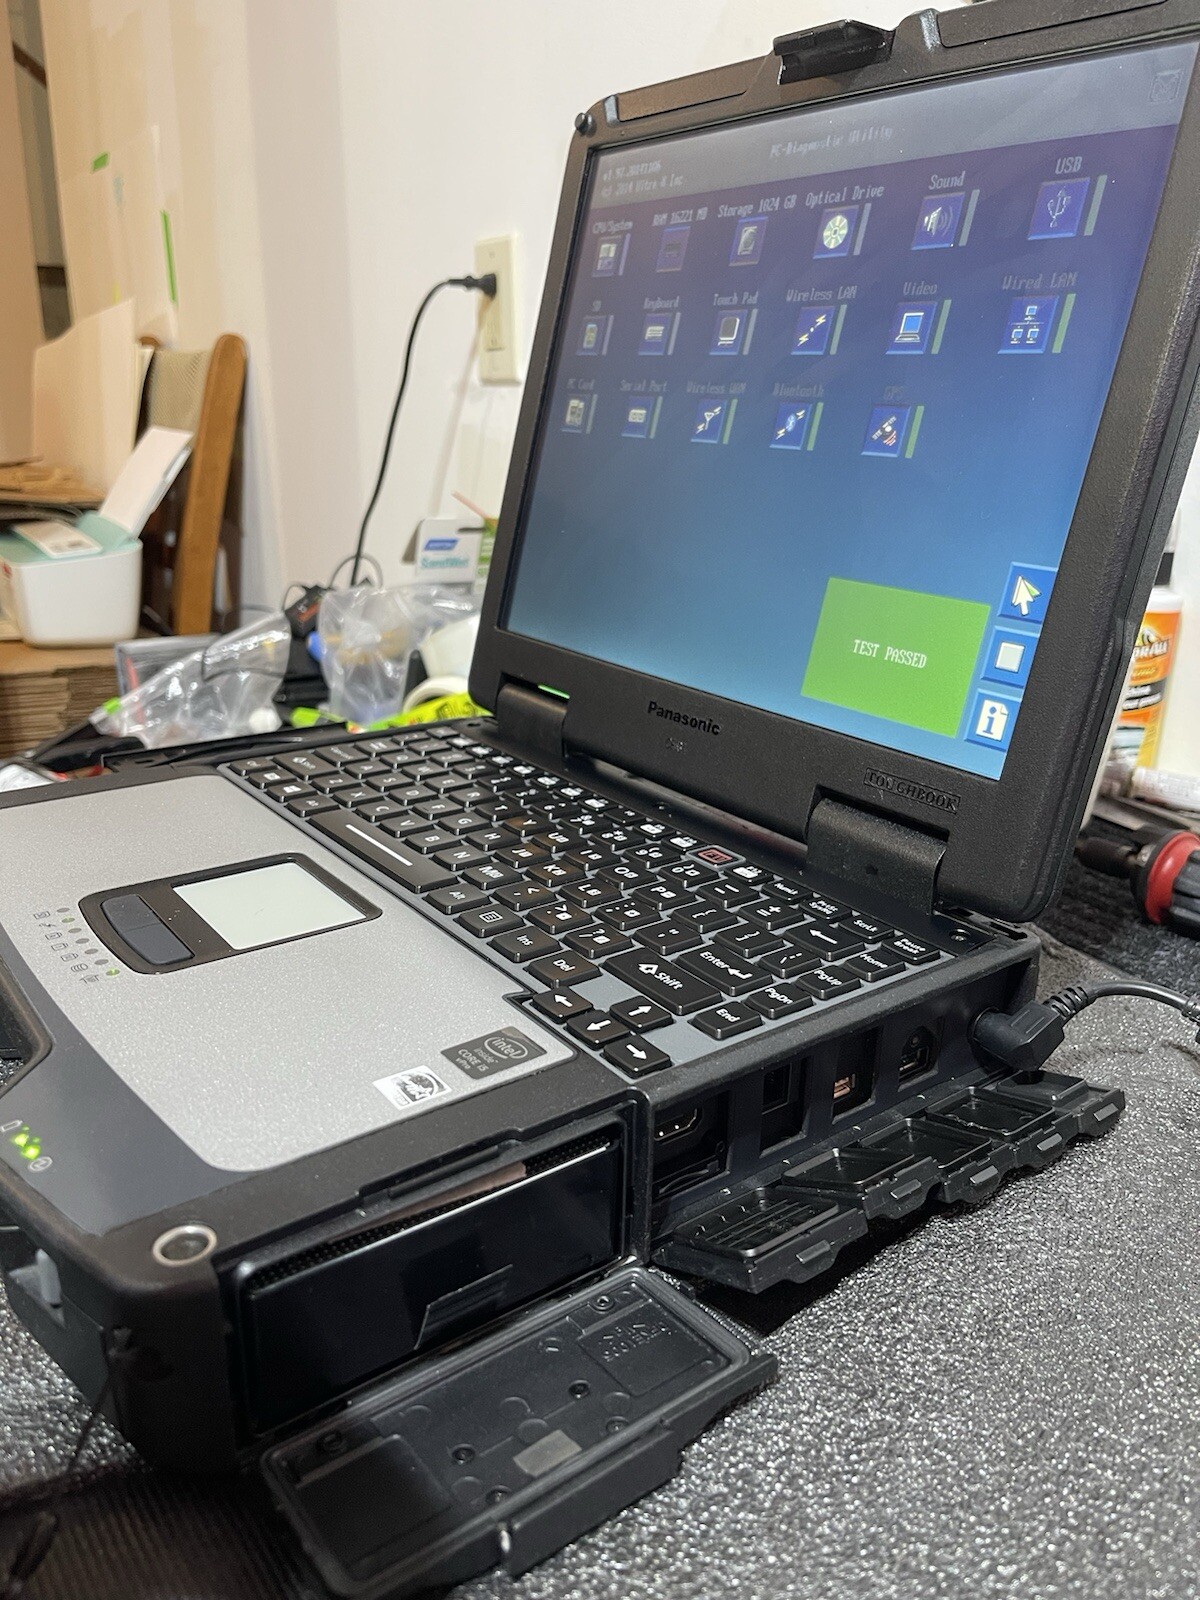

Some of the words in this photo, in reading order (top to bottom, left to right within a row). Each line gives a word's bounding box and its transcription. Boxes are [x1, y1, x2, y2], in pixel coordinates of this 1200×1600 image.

[1055, 156, 1083, 175] USB
[928, 171, 966, 190] Sound
[805, 190, 848, 208] Optical
[852, 185, 885, 201] Drive
[717, 203, 755, 219] Storage
[757, 198, 781, 214] 1024
[784, 194, 798, 210] GB
[903, 281, 938, 296] Video
[1002, 274, 1044, 291] Wired
[1050, 272, 1079, 288] LAN
[713, 293, 740, 306] Touch
[742, 291, 758, 305] Pad
[786, 287, 833, 302] Wireless
[838, 285, 858, 300] LAN
[686, 381, 726, 393] Wireless
[852, 639, 880, 658] TEST
[884, 646, 927, 669] PASSED
[647, 700, 721, 736] Panasonic
[866, 770, 959, 812] TOUGHBOOK
[484, 832, 501, 840] H
[547, 832, 560, 843] U
[453, 851, 471, 859] N
[511, 849, 522, 857] J
[542, 863, 556, 874] K
[615, 865, 631, 876] O
[577, 883, 592, 893] L
[650, 885, 667, 896] P
[517, 935, 533, 945] Ins
[553, 960, 575, 971] Del
[700, 952, 730, 970] Enter
[857, 951, 887, 968] Home
[655, 971, 682, 989] Shift
[812, 968, 842, 985] PgUp
[764, 986, 793, 1004] PgDn
[714, 1007, 740, 1022] End
[492, 1037, 521, 1059] intel
[456, 1058, 471, 1069] vPro
[458, 1049, 481, 1065] CORE
[477, 1063, 489, 1072] i5
